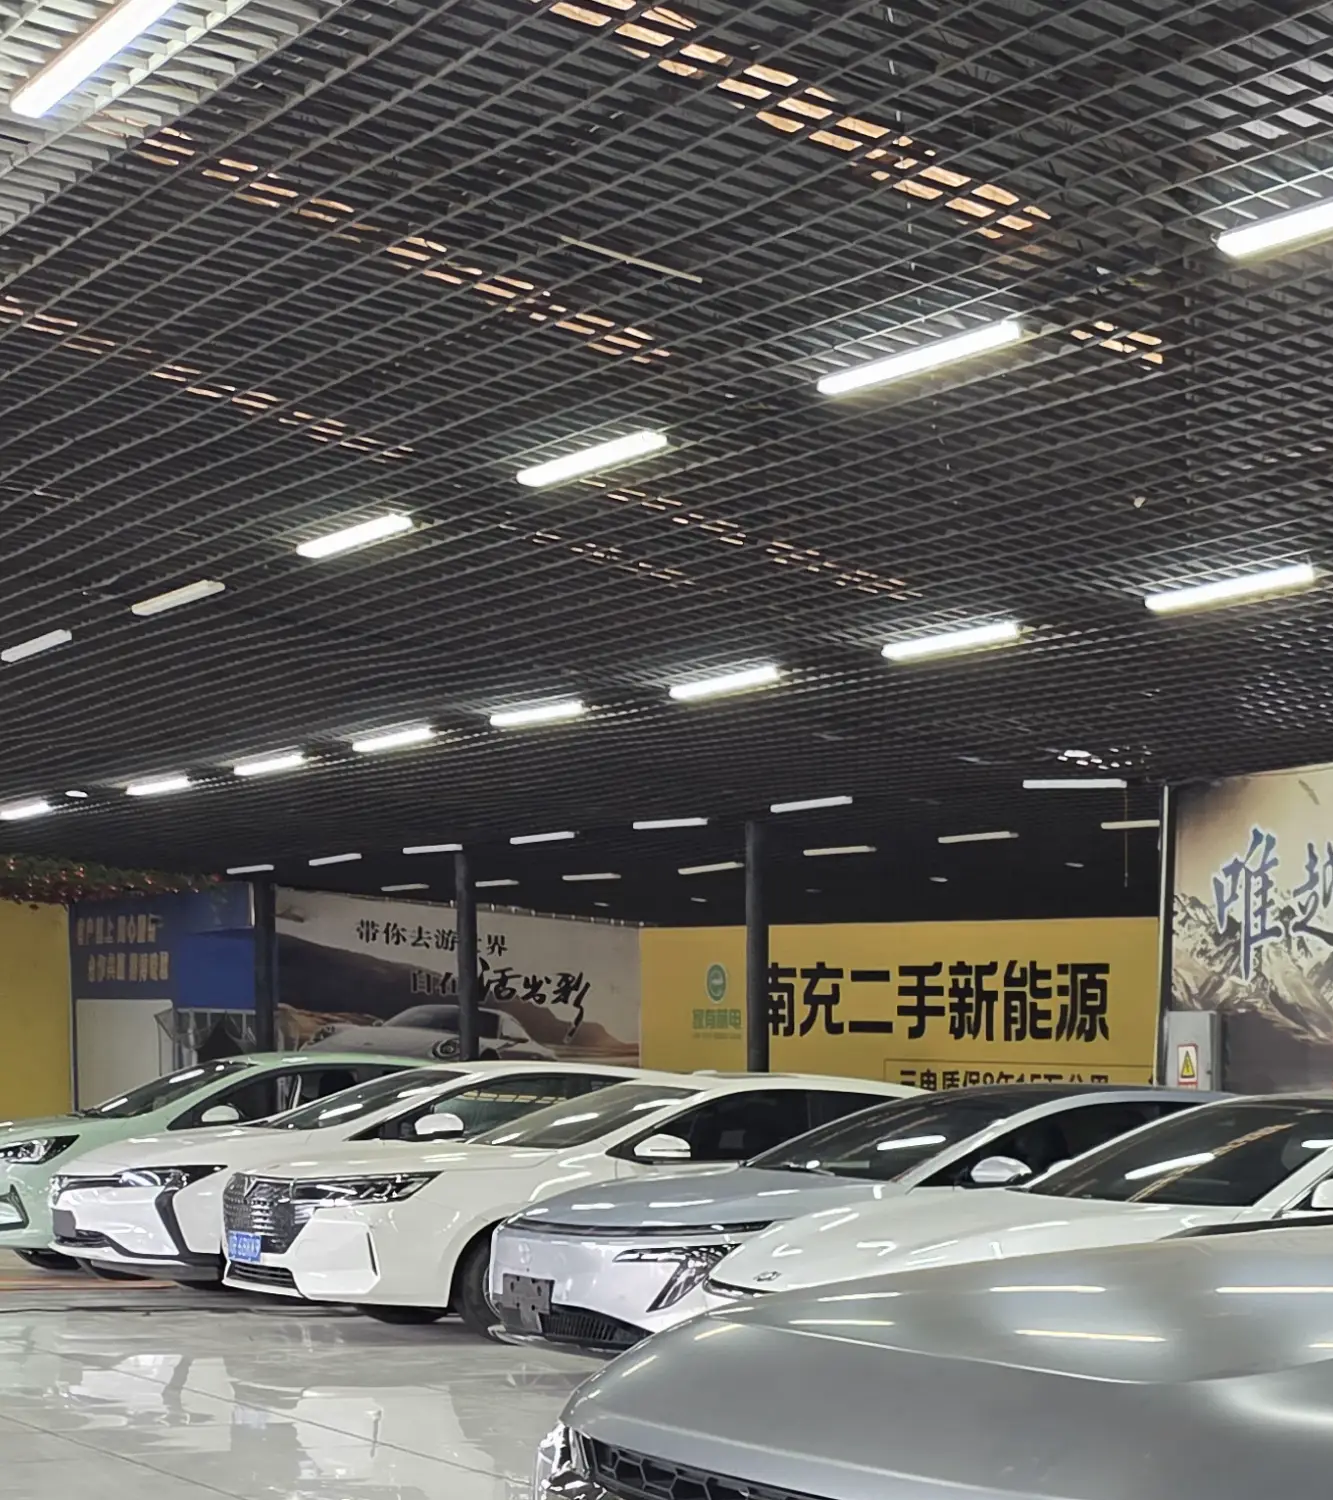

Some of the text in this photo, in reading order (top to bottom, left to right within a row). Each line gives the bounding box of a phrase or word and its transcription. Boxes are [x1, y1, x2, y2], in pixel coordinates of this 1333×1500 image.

[356, 918, 508, 957] 带你去游界
[767, 960, 1111, 1042] 南充二手新能源
